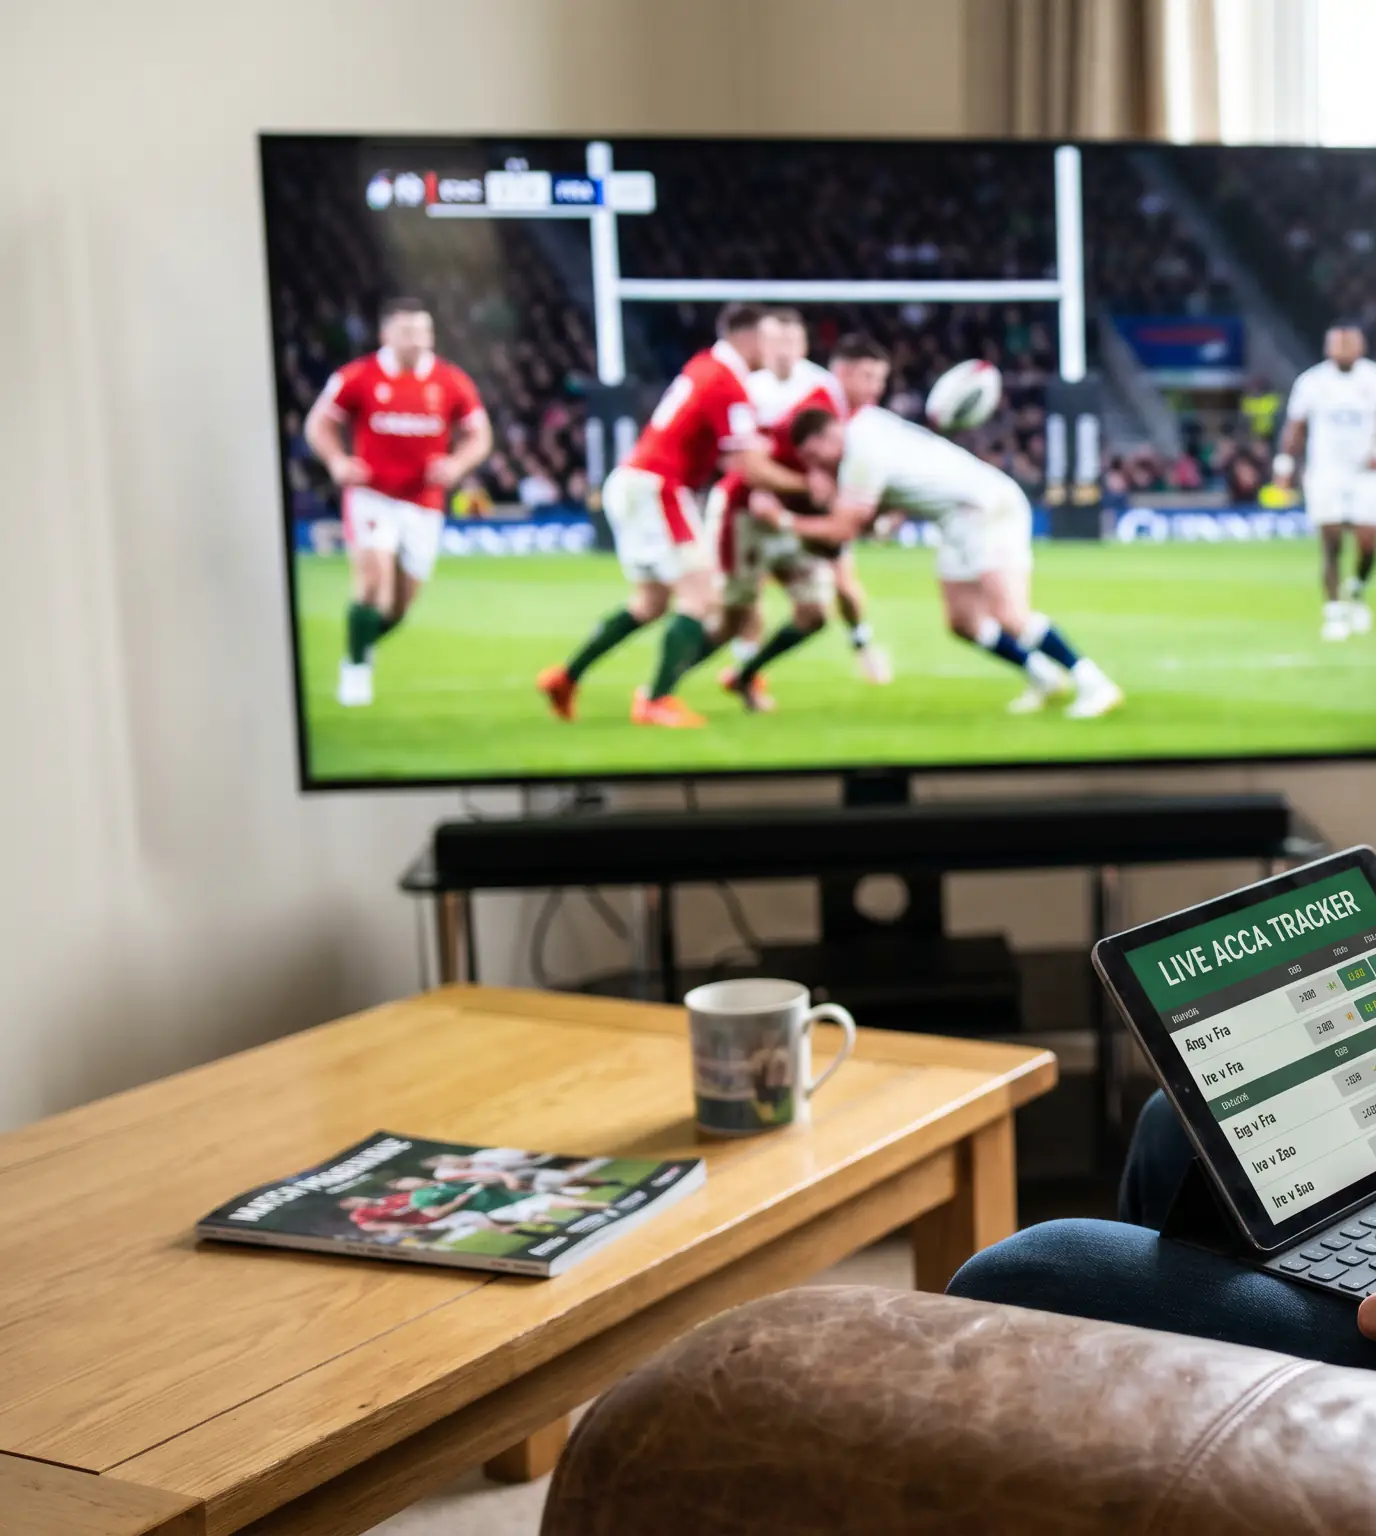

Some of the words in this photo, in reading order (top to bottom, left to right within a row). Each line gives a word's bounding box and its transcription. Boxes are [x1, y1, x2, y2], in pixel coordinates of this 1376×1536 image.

[1158, 946, 1212, 986] LIVE
[1213, 926, 1272, 966] ACCA
[1267, 891, 1360, 941] TRACKER
[1206, 1034, 1213, 1042] v
[1213, 1027, 1231, 1039] Fra
[1202, 1073, 1218, 1086] Ire
[1219, 1069, 1225, 1078] v
[1225, 1062, 1244, 1075] Fra
[1251, 1121, 1259, 1130] v
[1258, 1114, 1276, 1127] Fra
[1269, 1156, 1276, 1165] v
[1272, 1195, 1288, 1208] Ire
[1288, 1191, 1295, 1200] v
